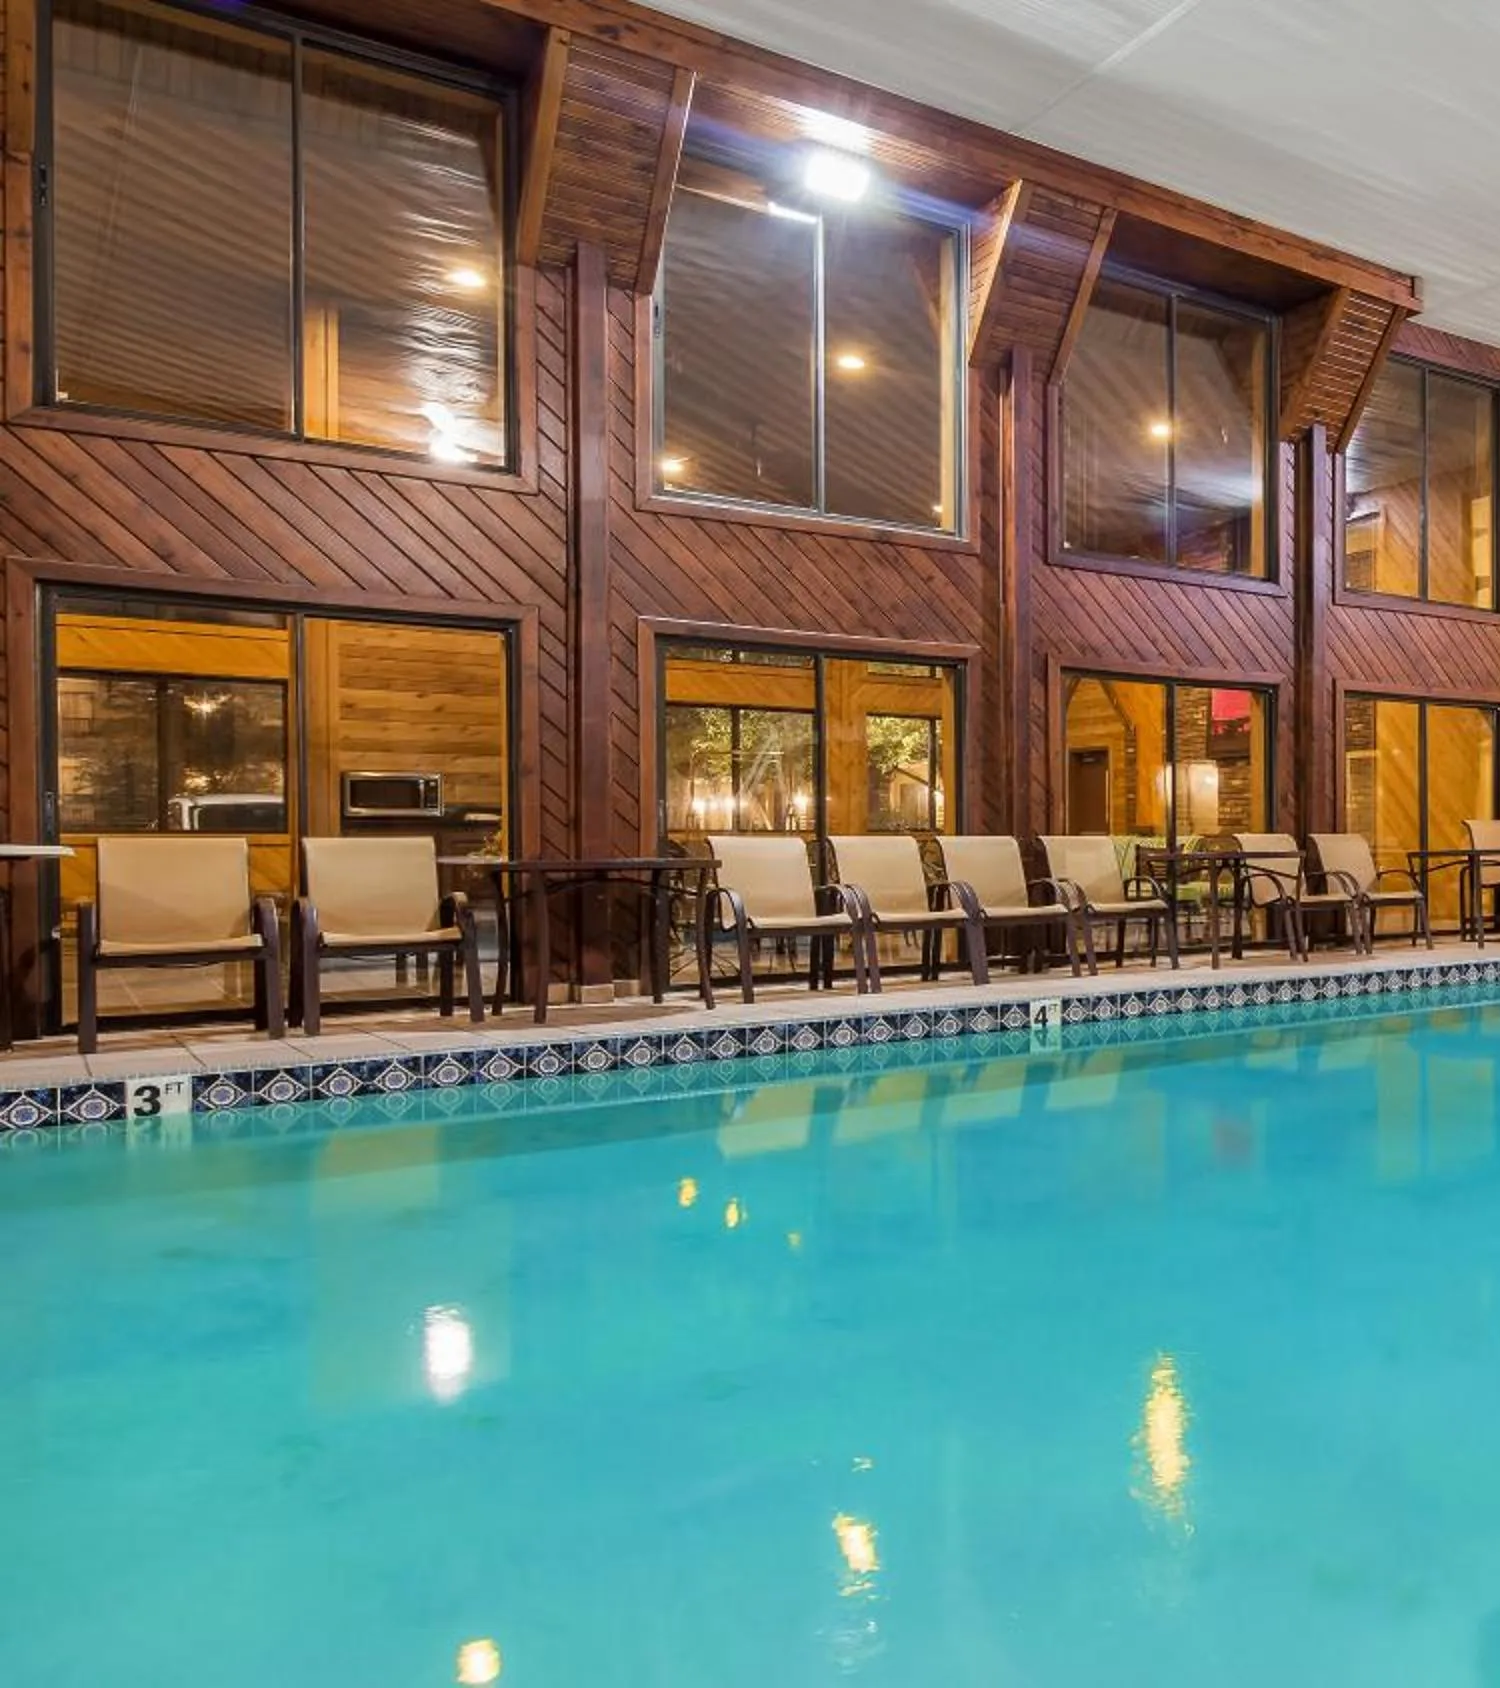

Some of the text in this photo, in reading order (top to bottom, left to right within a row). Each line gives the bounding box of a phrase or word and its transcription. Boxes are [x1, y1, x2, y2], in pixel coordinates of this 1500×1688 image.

[1033, 1004, 1049, 1026] 4
[133, 1081, 184, 1117] 3 FT
